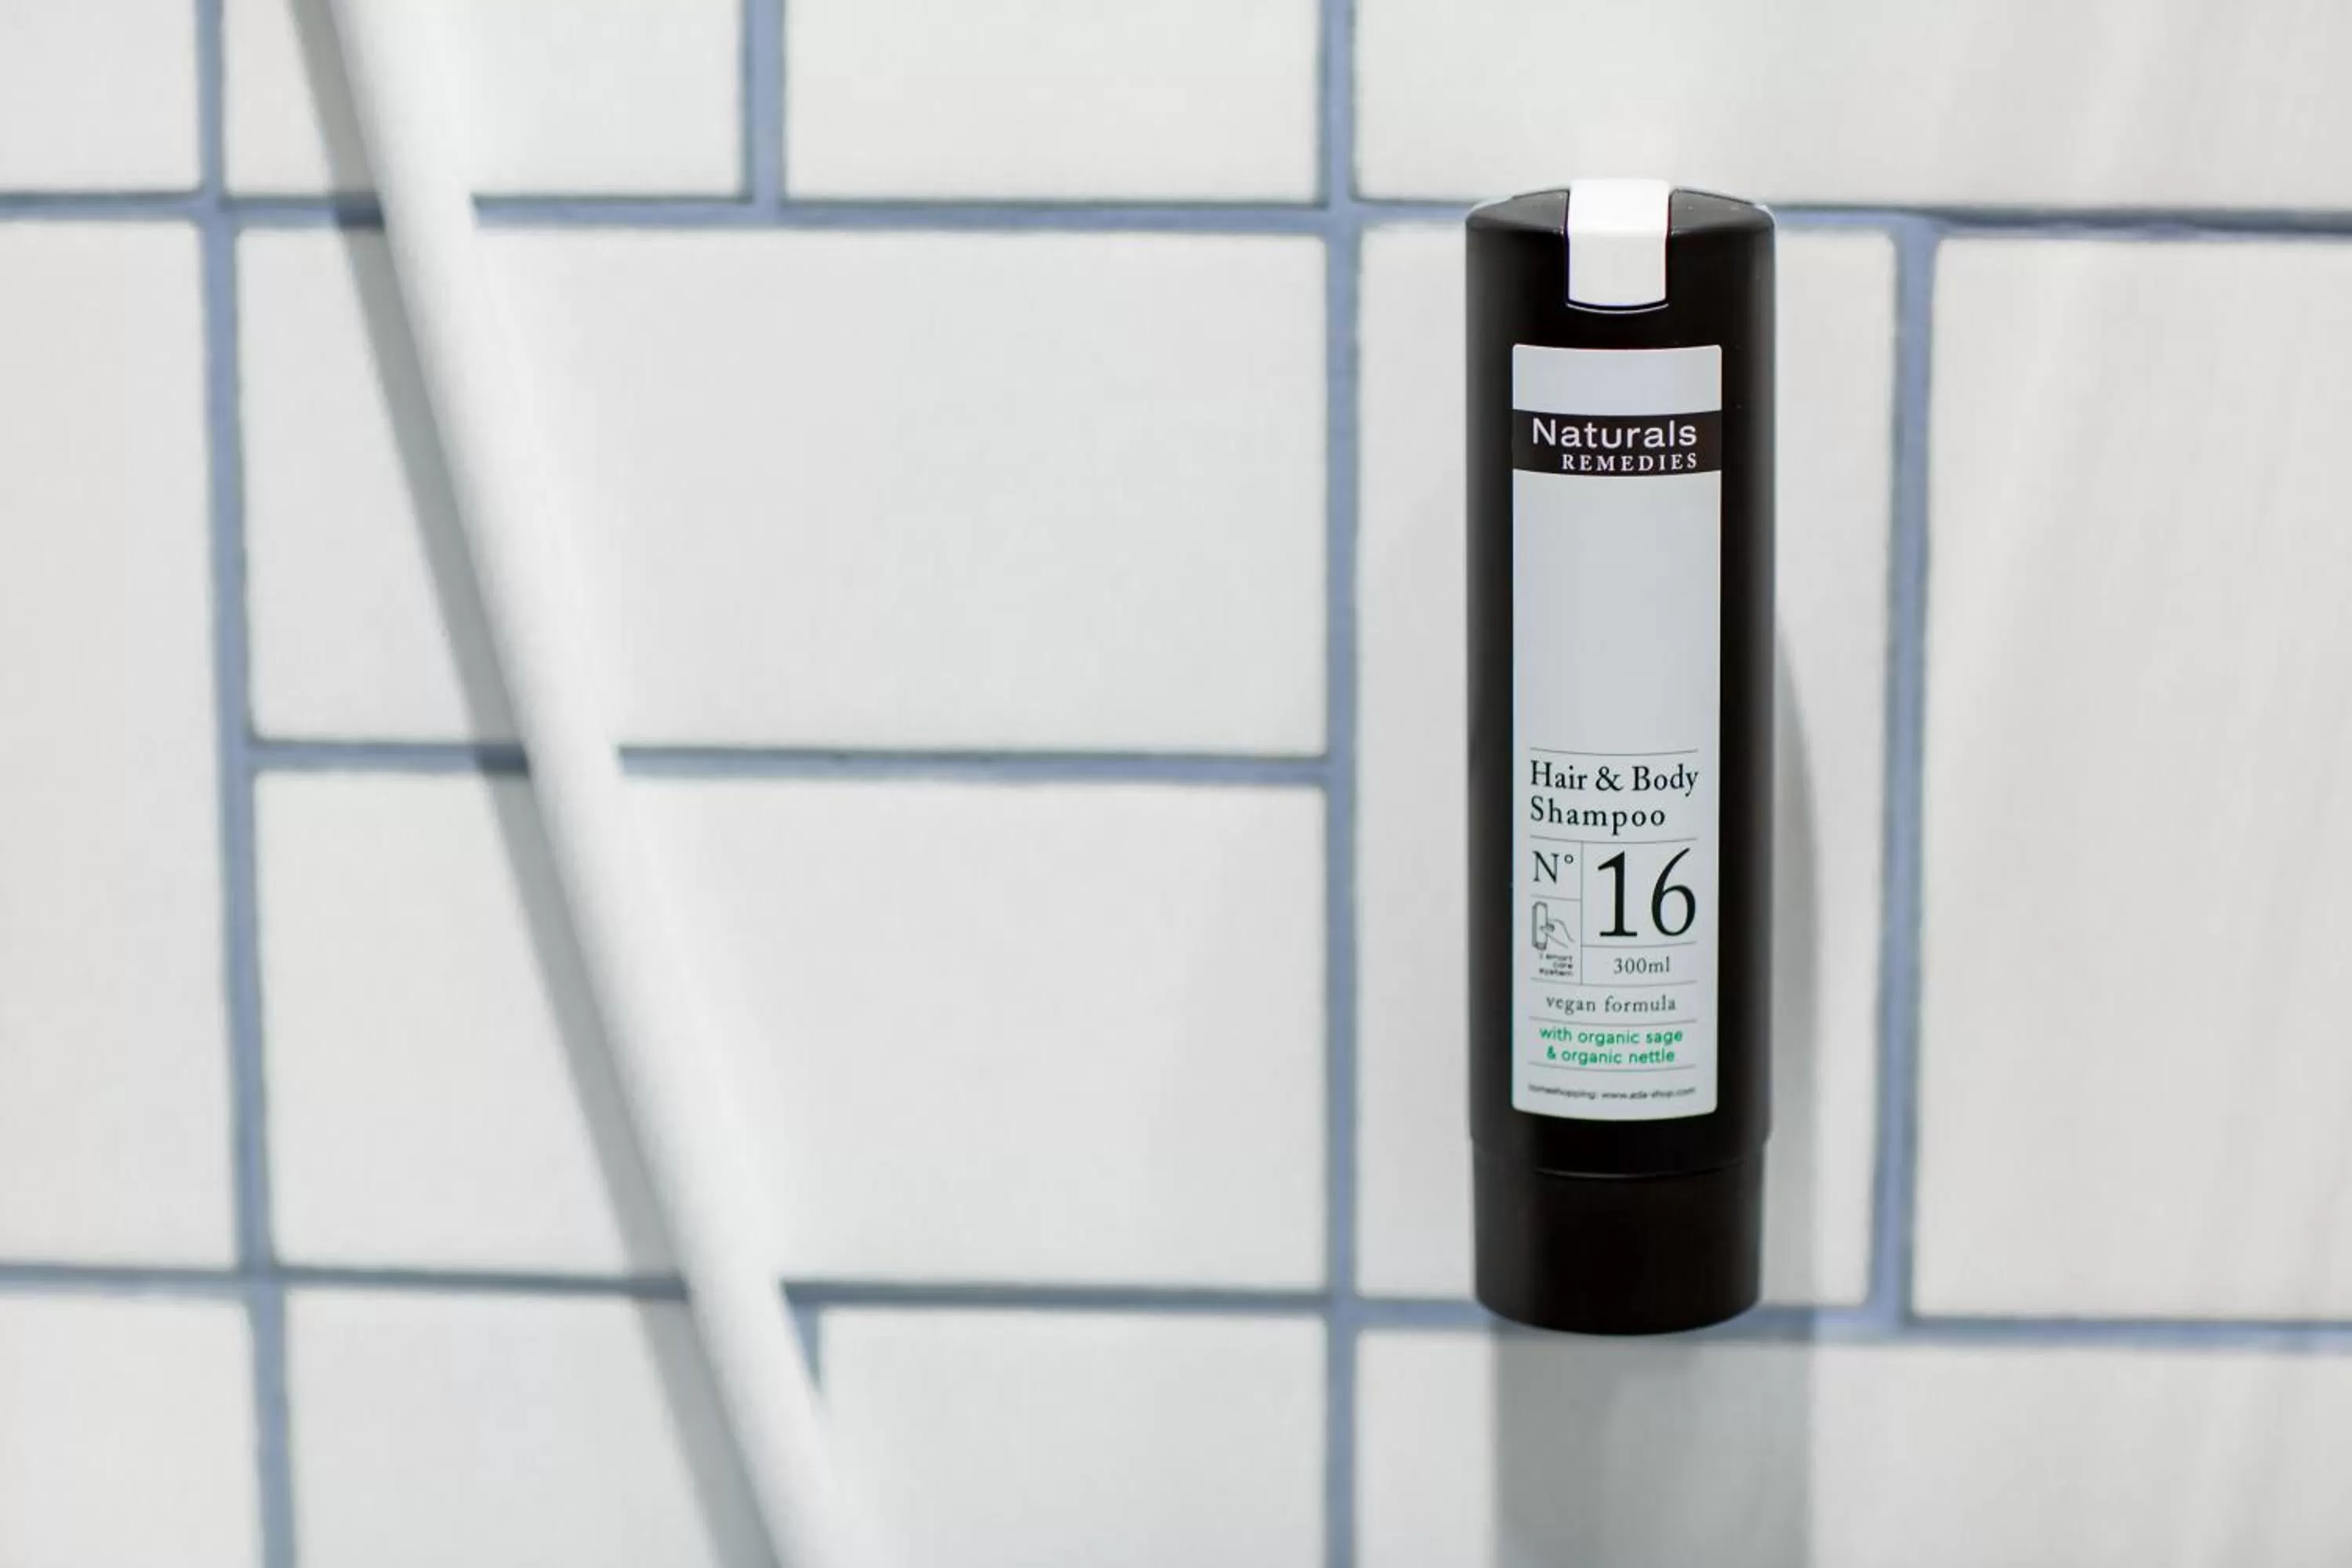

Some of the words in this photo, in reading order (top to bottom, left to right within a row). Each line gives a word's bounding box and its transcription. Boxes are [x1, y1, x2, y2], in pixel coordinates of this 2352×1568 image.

[1532, 417, 1697, 448] Naturals
[1562, 452, 1697, 472] REMEDIES
[1530, 760, 1588, 791] Hair
[1595, 765, 1624, 792] &
[1632, 762, 1699, 797] Body
[1530, 795, 1666, 836] Shampoo
[1597, 847, 1697, 937] 16
[1613, 956, 1671, 975] 300ml
[1545, 995, 1596, 1015] vegan
[1604, 994, 1676, 1013] formula
[1539, 1026, 1573, 1043] with
[1577, 1028, 1641, 1047] organic
[1645, 1028, 1684, 1046] sage
[1546, 1046, 1556, 1061] &
[1562, 1047, 1622, 1066] organic
[1628, 1047, 1675, 1065] nettle
